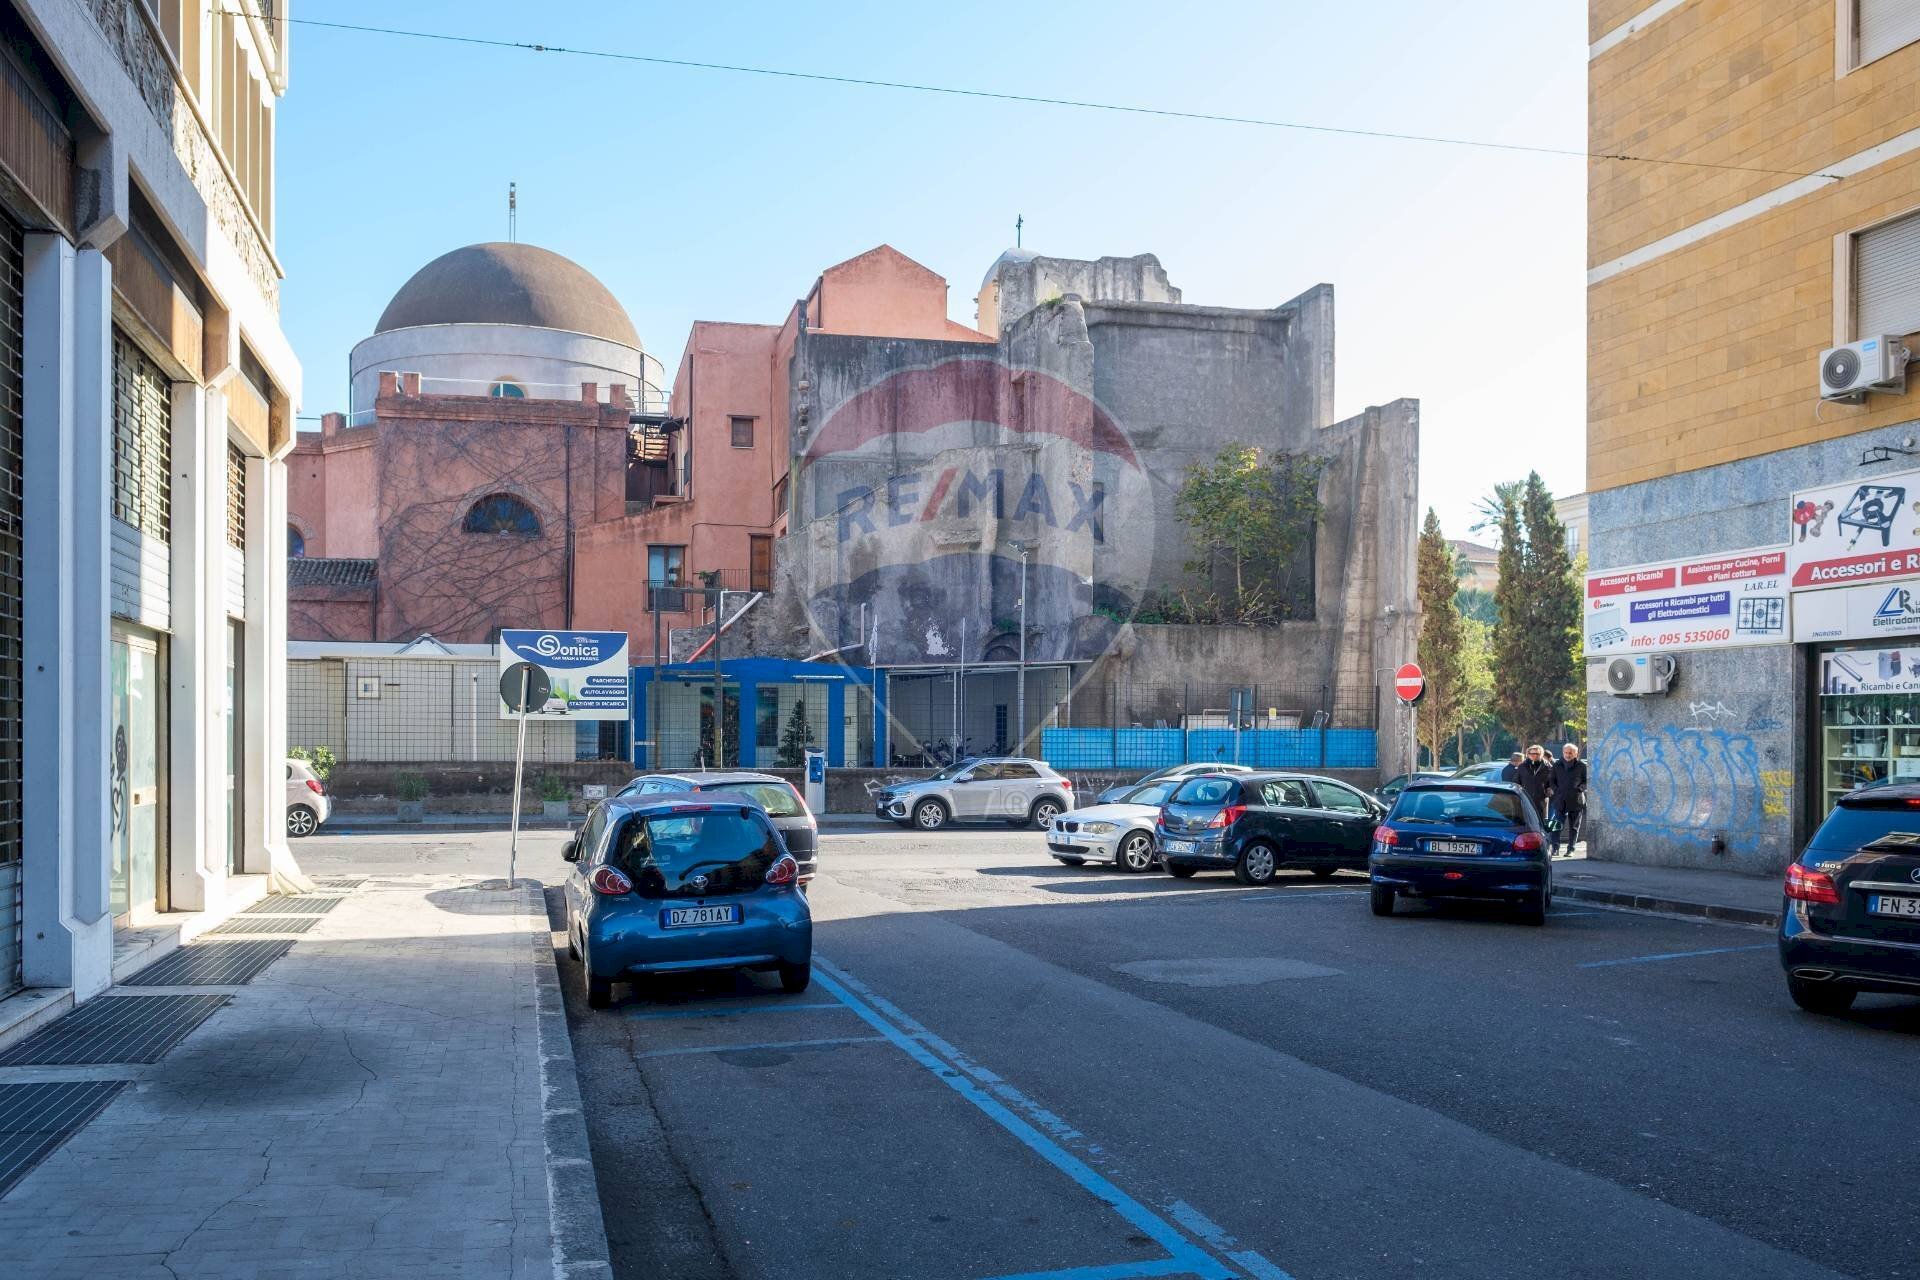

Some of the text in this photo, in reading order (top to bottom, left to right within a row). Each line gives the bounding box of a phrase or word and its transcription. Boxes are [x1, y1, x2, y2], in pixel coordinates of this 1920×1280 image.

[1687, 554, 1780, 574] Assistenza per Cucine, Forni
[1810, 553, 1920, 581] Accessori e R
[1600, 575, 1629, 587] Accessori
[1636, 570, 1663, 582] Ricambi
[1714, 571, 1730, 581] Piani
[1731, 569, 1757, 578] cottura
[1624, 585, 1637, 593] Gas
[1634, 601, 1663, 611] Accessori
[1670, 595, 1696, 607] Ricambi
[1697, 596, 1709, 605] per
[1710, 592, 1725, 602] tutti
[1648, 605, 1710, 621] gli Elettrodomestici
[537, 635, 599, 657] Sonica
[1630, 628, 1730, 647] info: 095 535060
[1861, 681, 1894, 691] Ricambi
[1902, 681, 1920, 690] Can
[1431, 841, 1476, 853] BL 195MZ
[1880, 898, 1920, 913] FN 3
[672, 907, 730, 924] DZ 781AY
